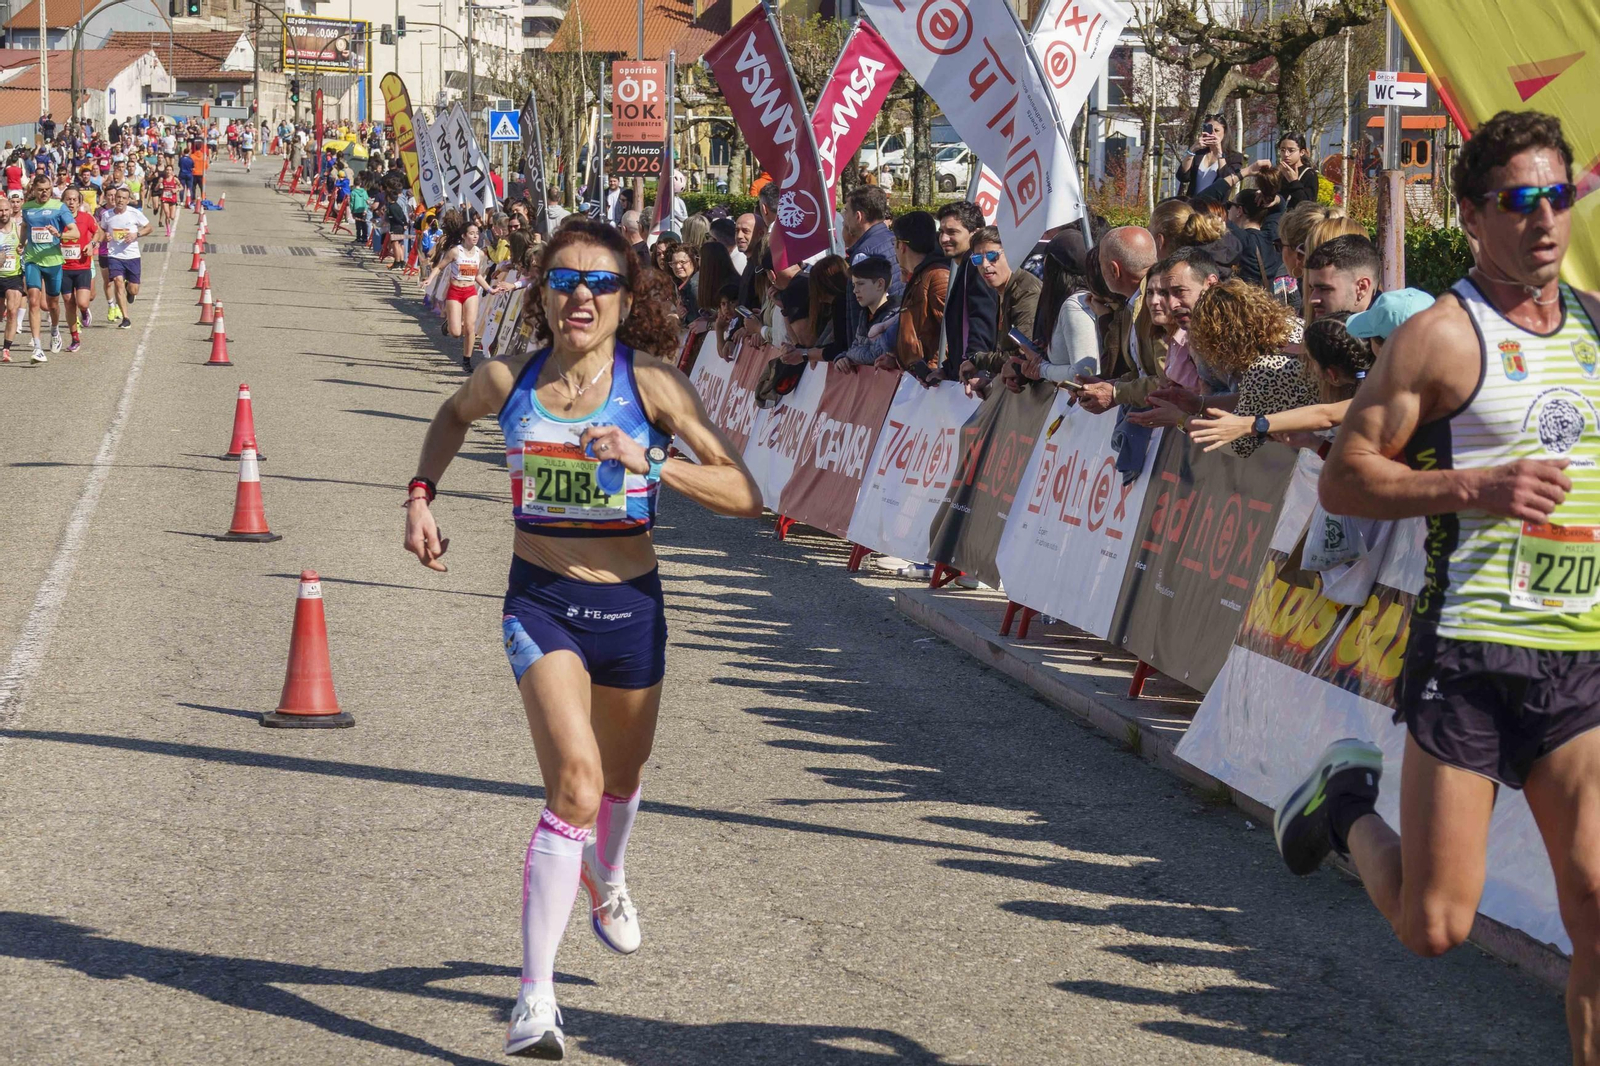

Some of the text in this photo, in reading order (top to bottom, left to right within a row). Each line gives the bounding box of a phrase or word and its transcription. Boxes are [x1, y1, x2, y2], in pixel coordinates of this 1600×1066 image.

[619, 66, 657, 76] oporriño
[1375, 84, 1394, 100] WC
[735, 31, 800, 189] CAMSA
[1027, 109, 1040, 136] Experts
[617, 156, 660, 172] 2026
[815, 418, 872, 480] CEAMSA
[544, 458, 598, 470] JULIA VAQUER
[1141, 471, 1273, 590] adhex
[1565, 545, 1595, 553] MATIAS
[602, 611, 632, 621] seguros
